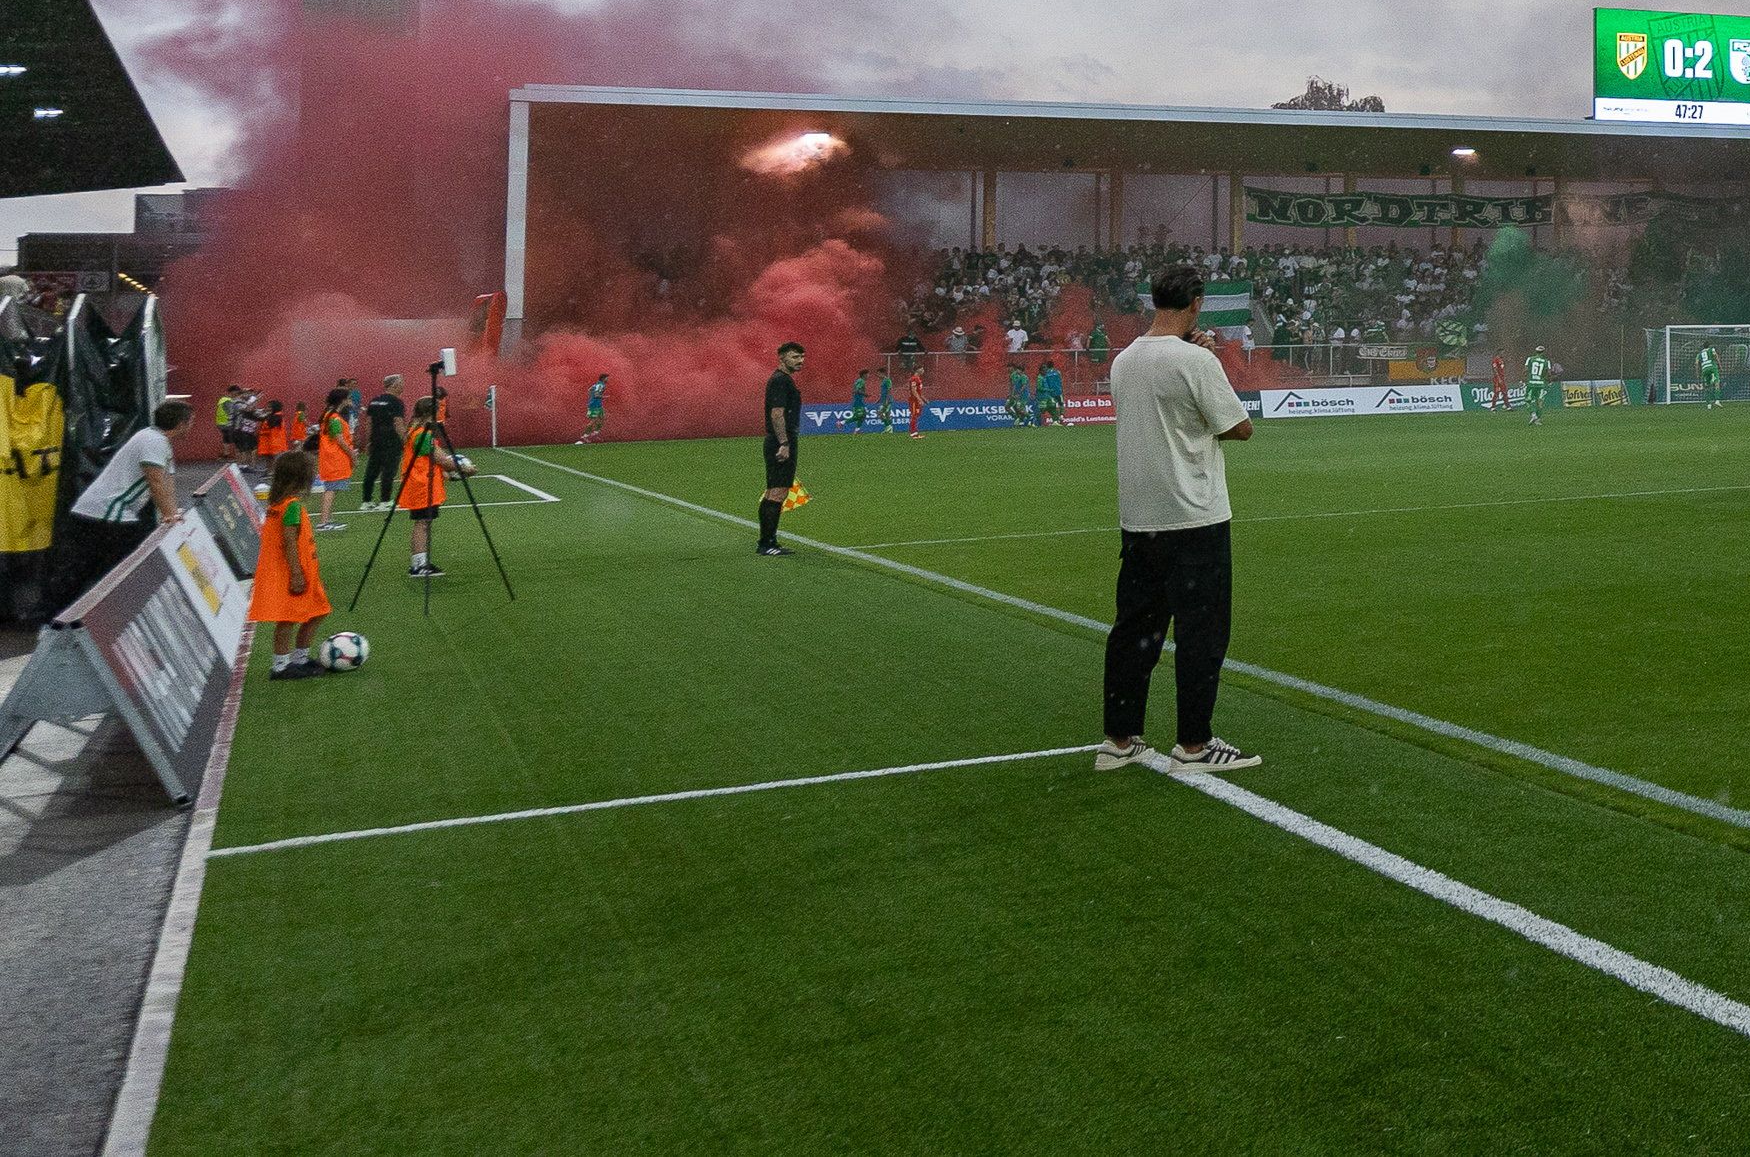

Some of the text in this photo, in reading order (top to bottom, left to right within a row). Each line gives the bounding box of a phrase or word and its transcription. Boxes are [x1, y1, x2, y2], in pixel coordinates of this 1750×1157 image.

[1656, 14, 1707, 33] AUSTRIA
[1664, 39, 1713, 78] 0:2
[1675, 104, 1704, 119] 47:27
[1531, 361, 1544, 376] 61
[1670, 383, 1703, 391] SUN
[1068, 399, 1080, 408] ba
[1083, 399, 1096, 408] da
[1098, 398, 1112, 407] ba
[1311, 398, 1354, 407] bösch
[1411, 394, 1453, 404] bösch
[956, 405, 1034, 415] VOLKSBK
